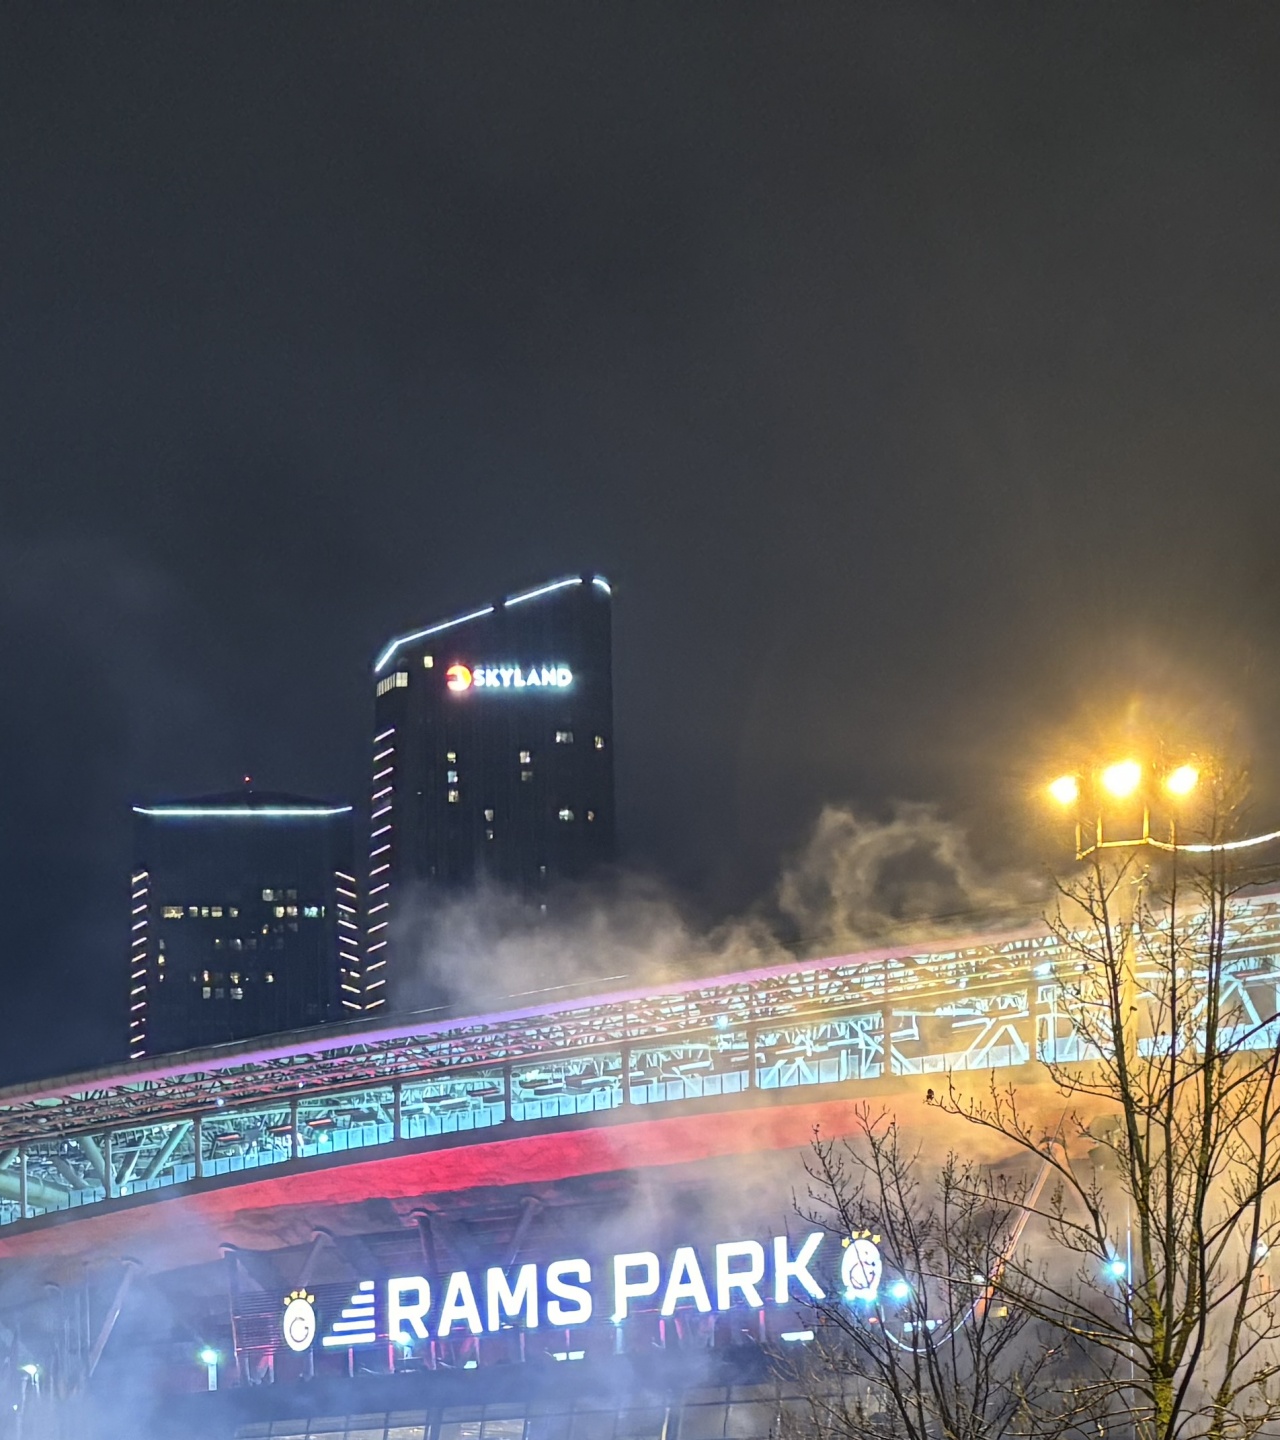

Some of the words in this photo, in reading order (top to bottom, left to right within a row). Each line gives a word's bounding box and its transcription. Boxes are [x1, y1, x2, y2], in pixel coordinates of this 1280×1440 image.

[473, 668, 573, 688] SKYLAND
[387, 1258, 593, 1342] RAMS
[613, 1231, 827, 1323] PARK
